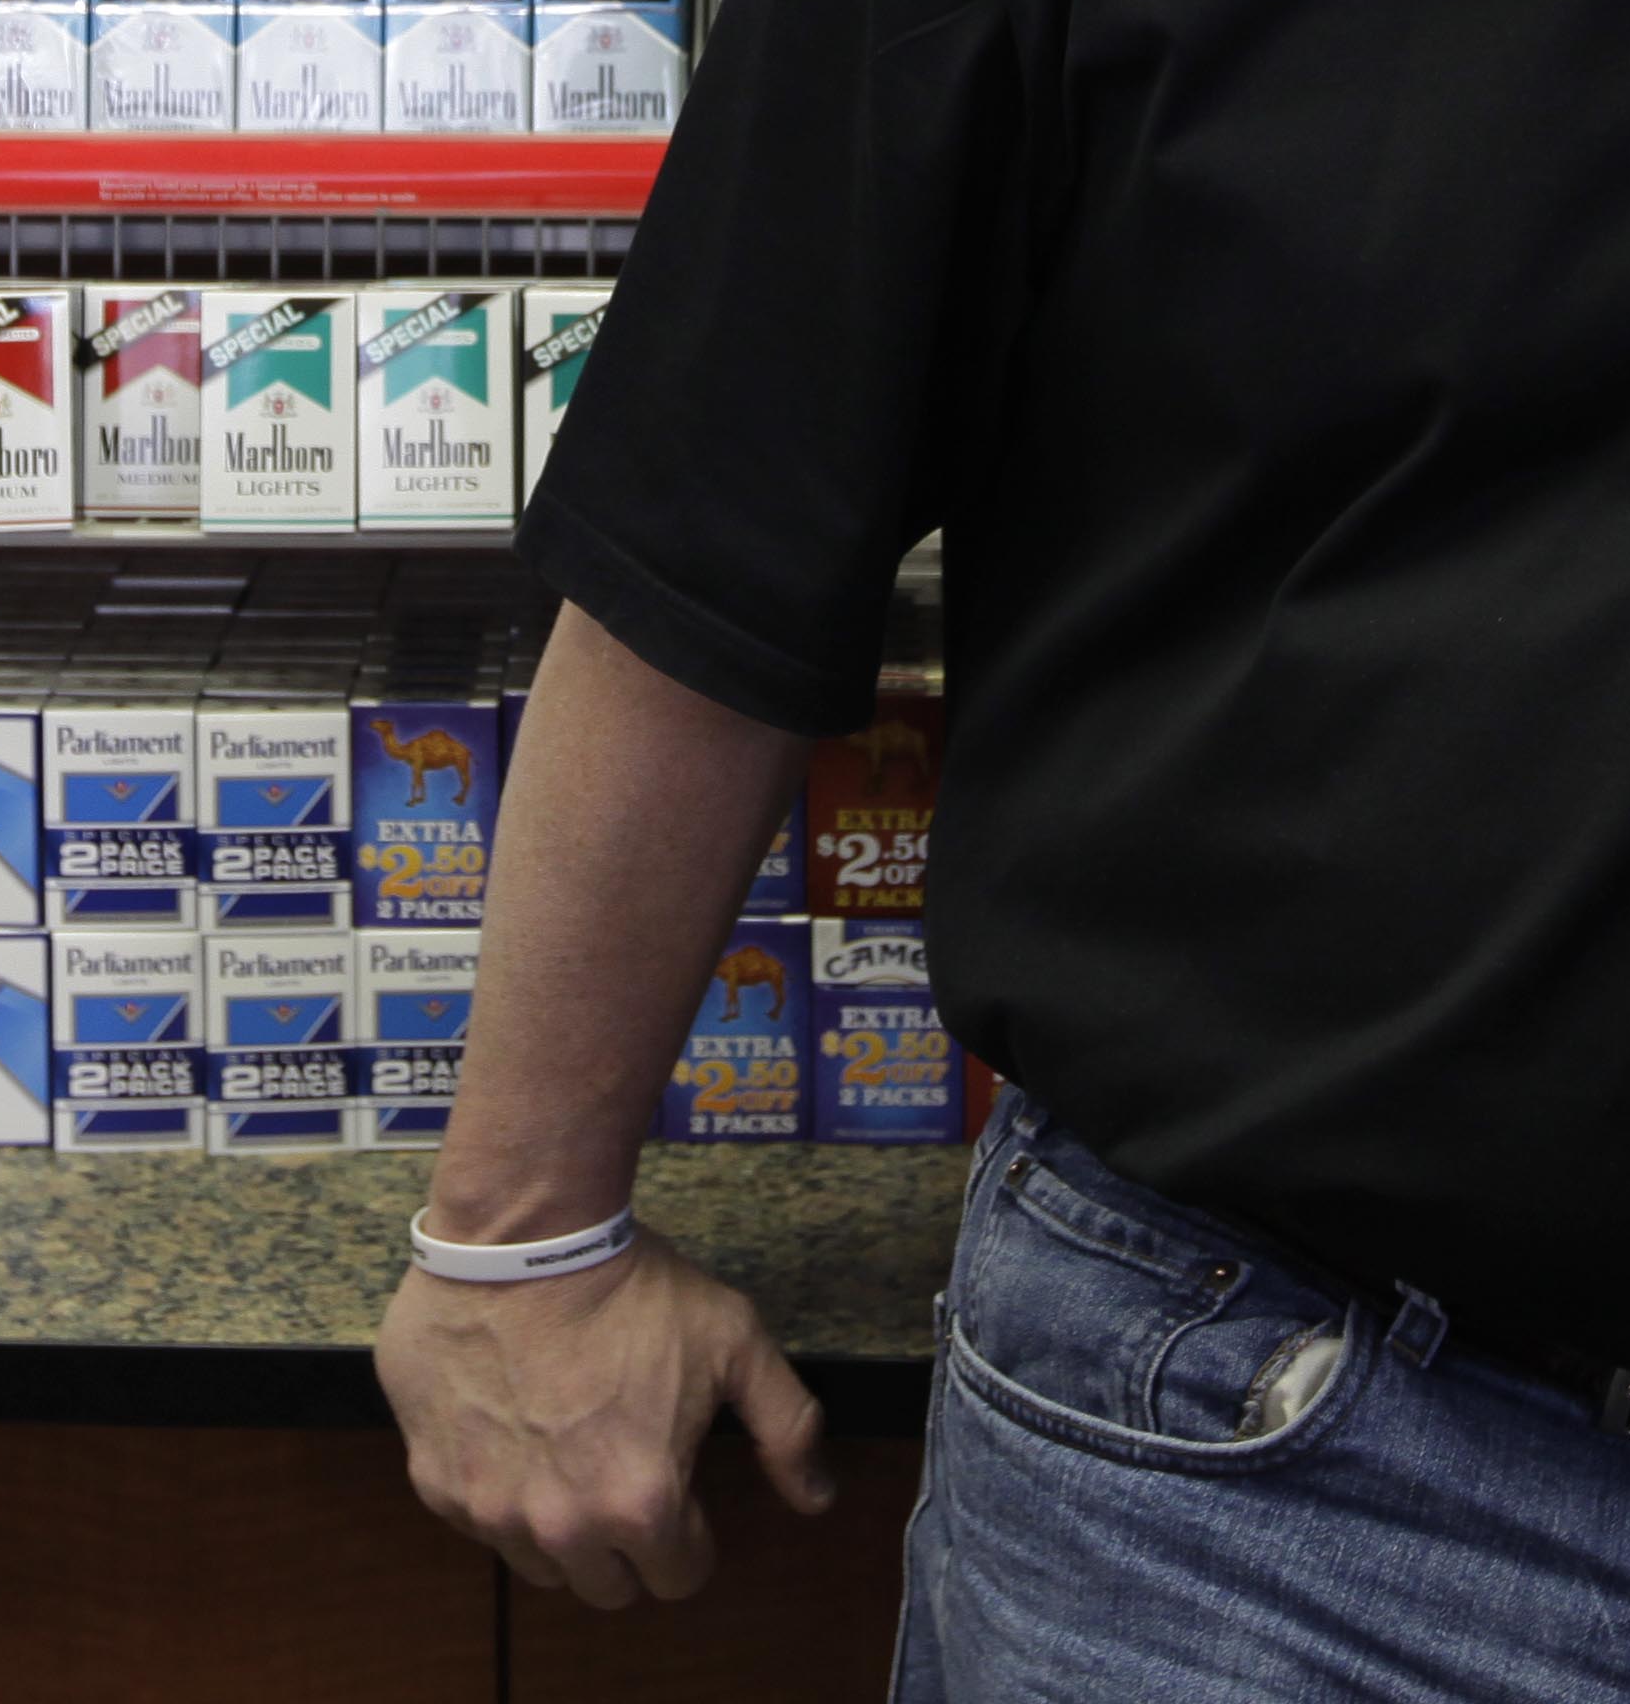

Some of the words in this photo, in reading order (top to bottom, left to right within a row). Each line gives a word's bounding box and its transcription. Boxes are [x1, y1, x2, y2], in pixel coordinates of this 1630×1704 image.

[547, 65, 666, 119] Marlboro
[208, 302, 305, 370] SPECIAL
[366, 298, 460, 364] SPECIAL
[225, 424, 334, 473] Marlboro
[236, 479, 320, 496] LIGHTS
[57, 726, 182, 755] Parliament
[378, 821, 482, 843] EXTRA
[359, 845, 485, 897] $2.50
[424, 875, 485, 895] OFF
[378, 902, 394, 920] 2
[399, 901, 483, 920] PACKS
[219, 950, 345, 979] Parliament
[691, 1037, 795, 1058] EXTRA
[221, 1064, 258, 1097] 2
[263, 1063, 344, 1081] PACK
[262, 1079, 346, 1097] PRICE
[736, 1092, 797, 1111] OFF
[691, 1116, 706, 1133] 2
[713, 1115, 797, 1134] PACKS
